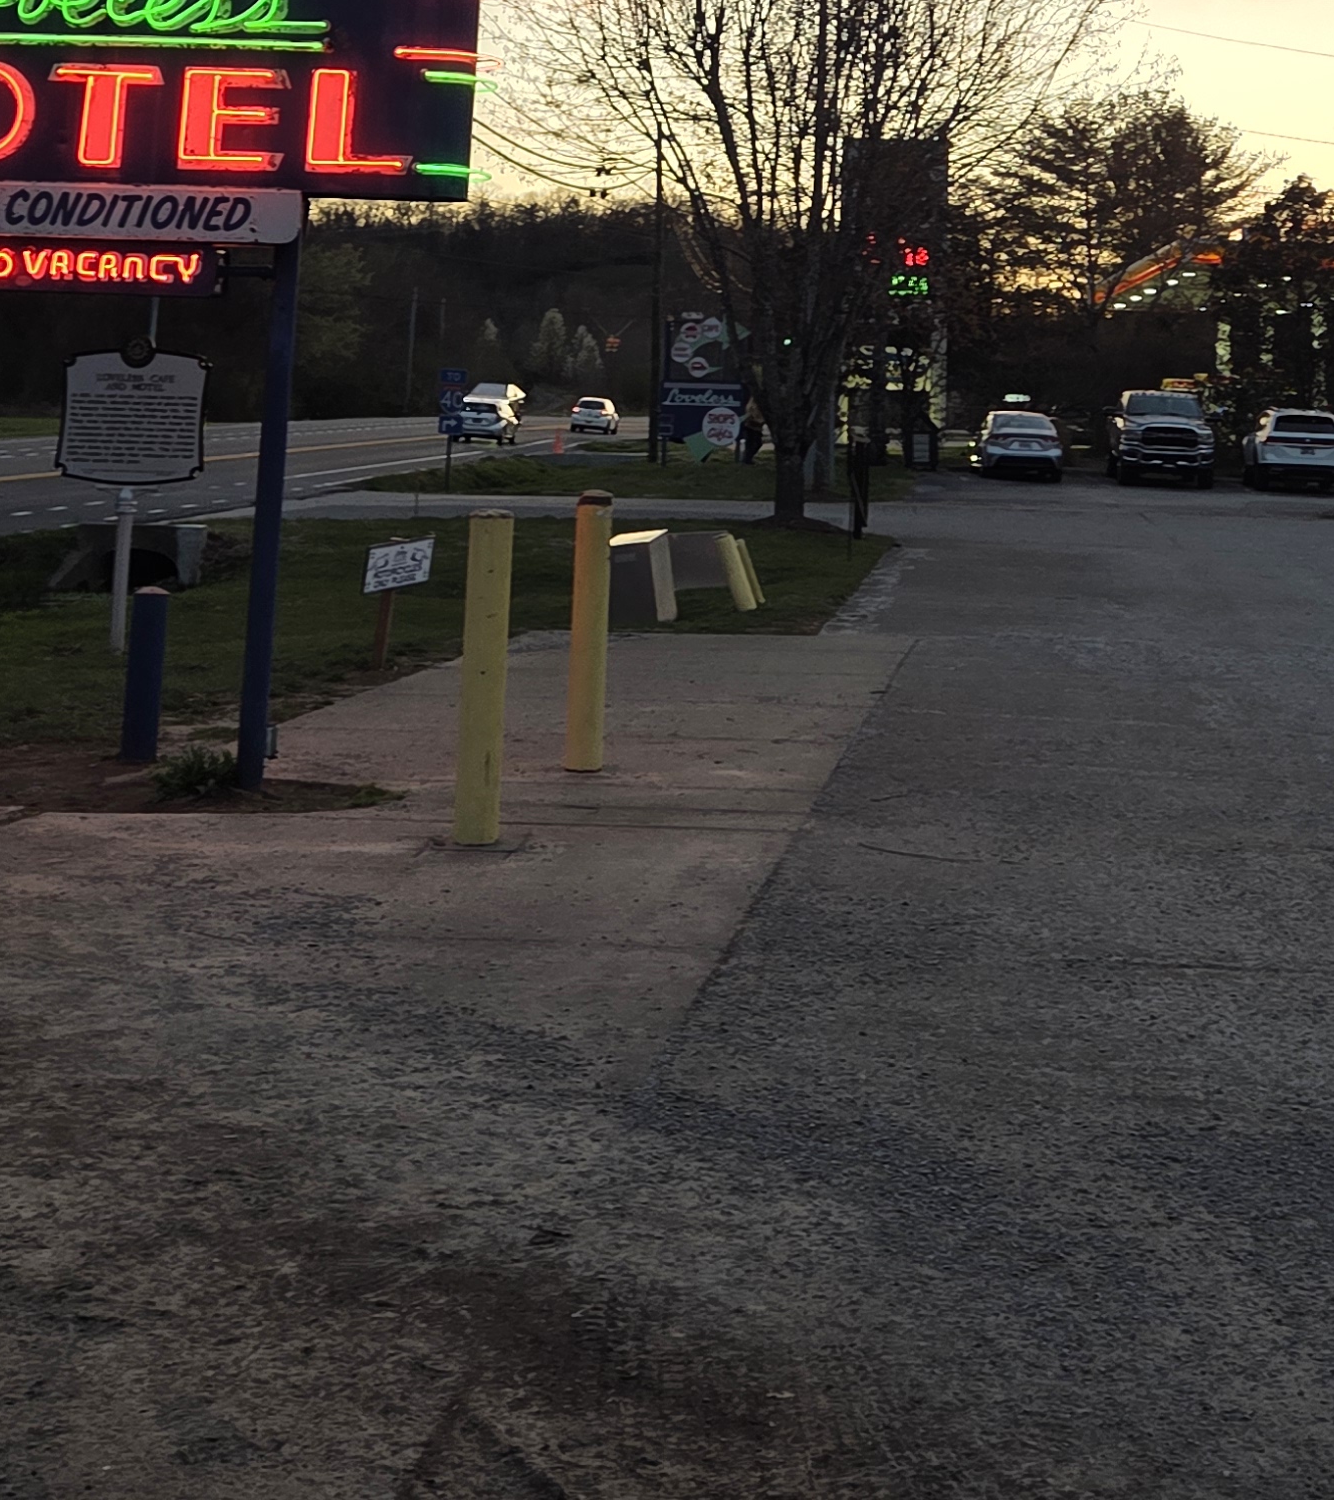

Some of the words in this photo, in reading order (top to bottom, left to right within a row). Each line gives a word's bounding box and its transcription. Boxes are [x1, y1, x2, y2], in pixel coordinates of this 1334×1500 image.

[22, 249, 202, 283] VACANCY
[439, 390, 463, 408] 40
[666, 388, 735, 403] Loveless
